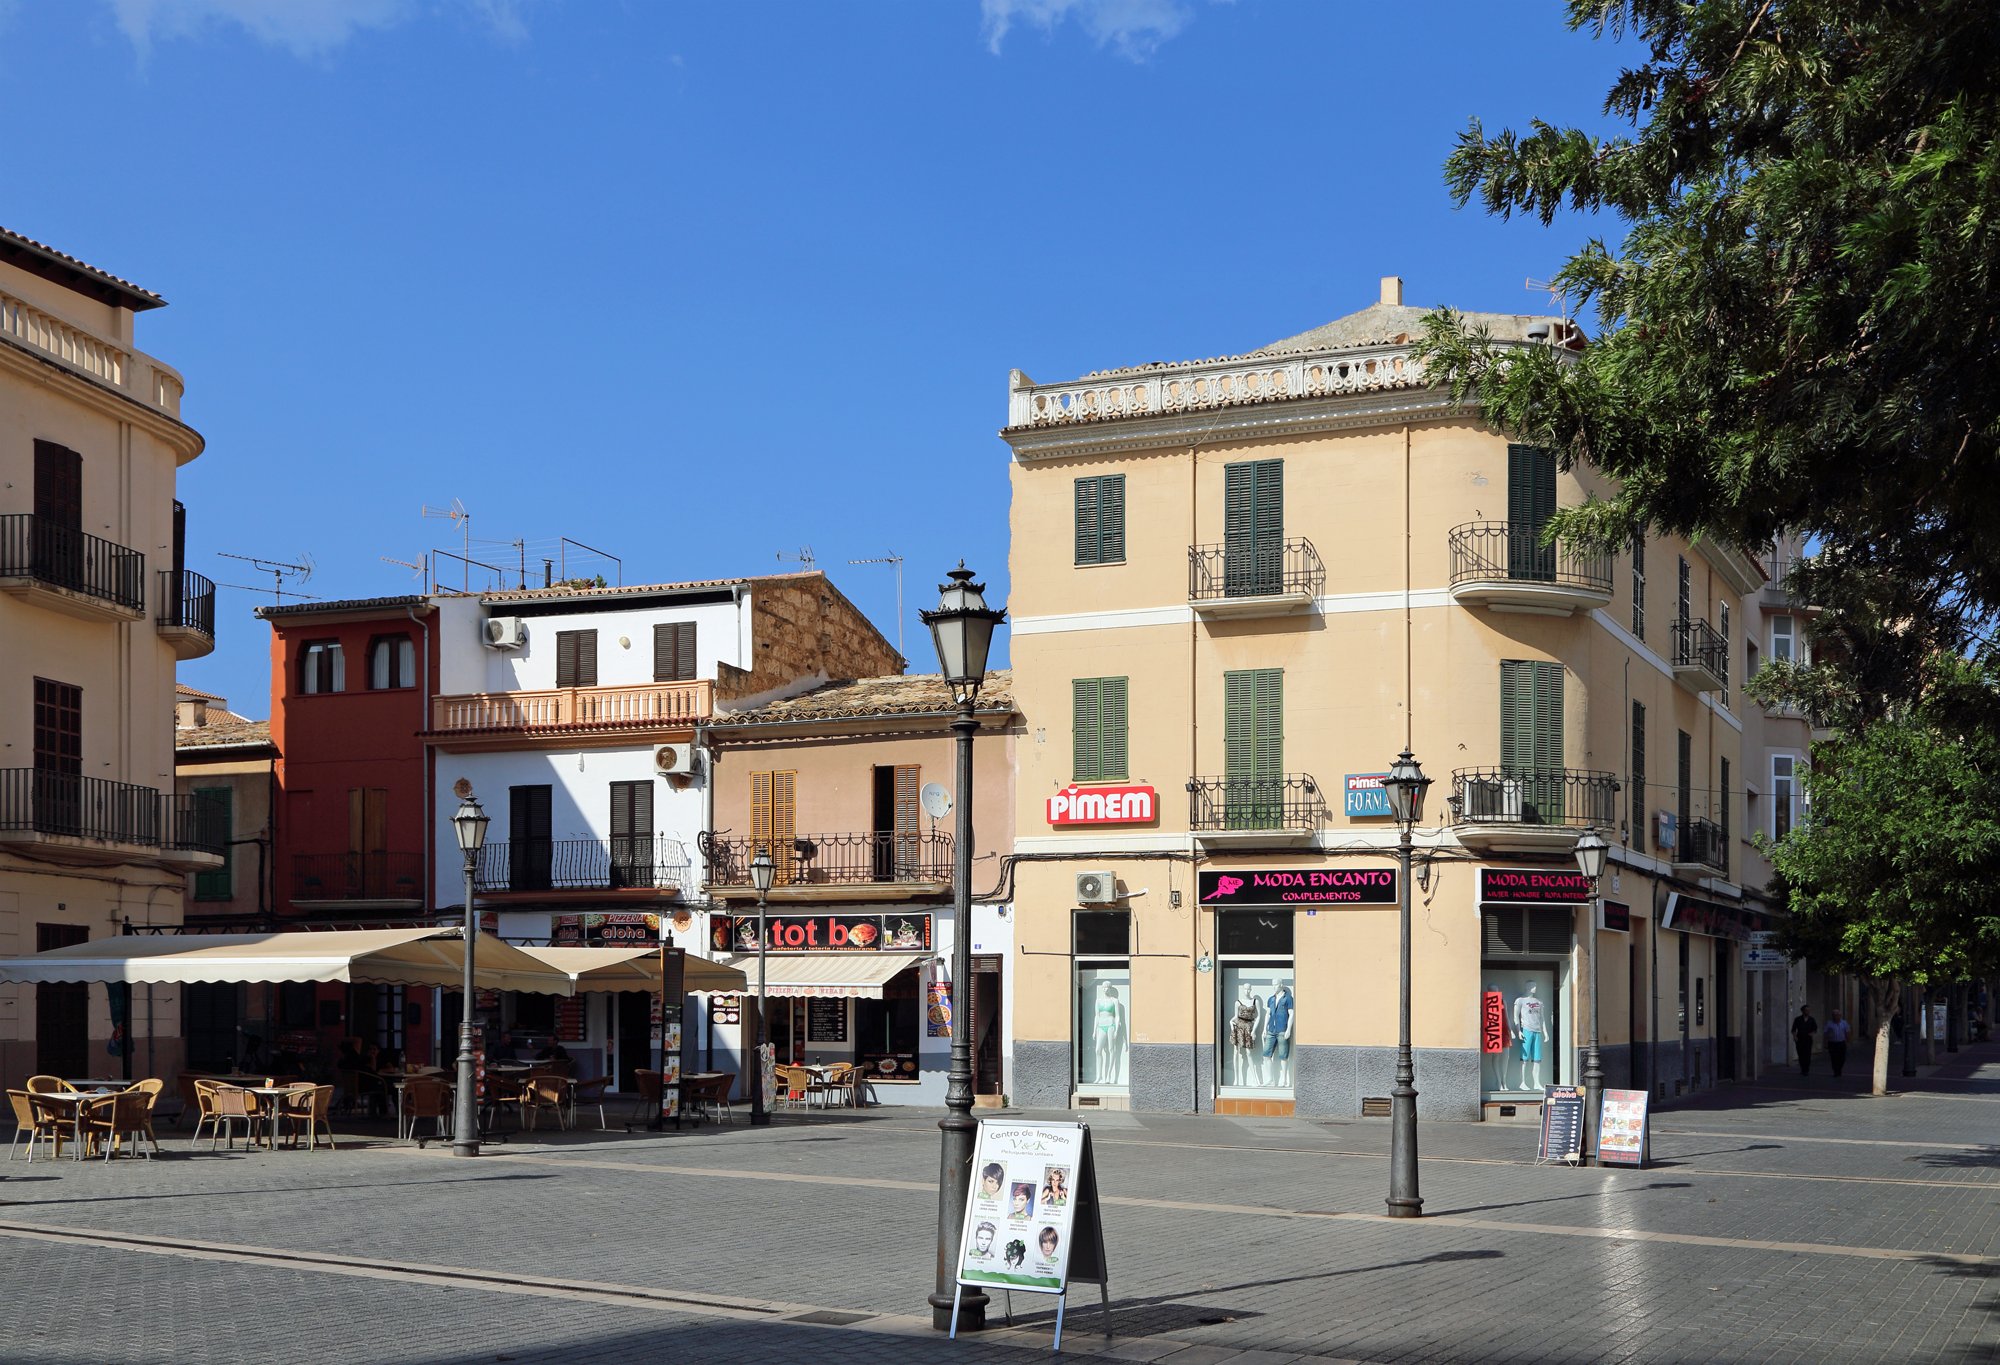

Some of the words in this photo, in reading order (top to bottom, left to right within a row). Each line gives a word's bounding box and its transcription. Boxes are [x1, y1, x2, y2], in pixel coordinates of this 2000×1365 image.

[1348, 792, 1391, 811] FORMA
[1254, 872, 1307, 887] MODA
[1310, 871, 1392, 886] ENCANTO
[1487, 874, 1528, 887] MODA
[1282, 891, 1361, 902] COMPLEMENTOS
[608, 914, 644, 923] PIZZERIA
[601, 925, 645, 939] aloha
[772, 918, 818, 946] tot
[767, 987, 799, 995] PIZZERIA
[819, 987, 844, 995] KEBAB
[1485, 995, 1500, 1050] REBAJAS
[1552, 1091, 1577, 1099] aloha
[990, 1131, 1019, 1140] Centro
[1036, 1130, 1070, 1145] Imagen
